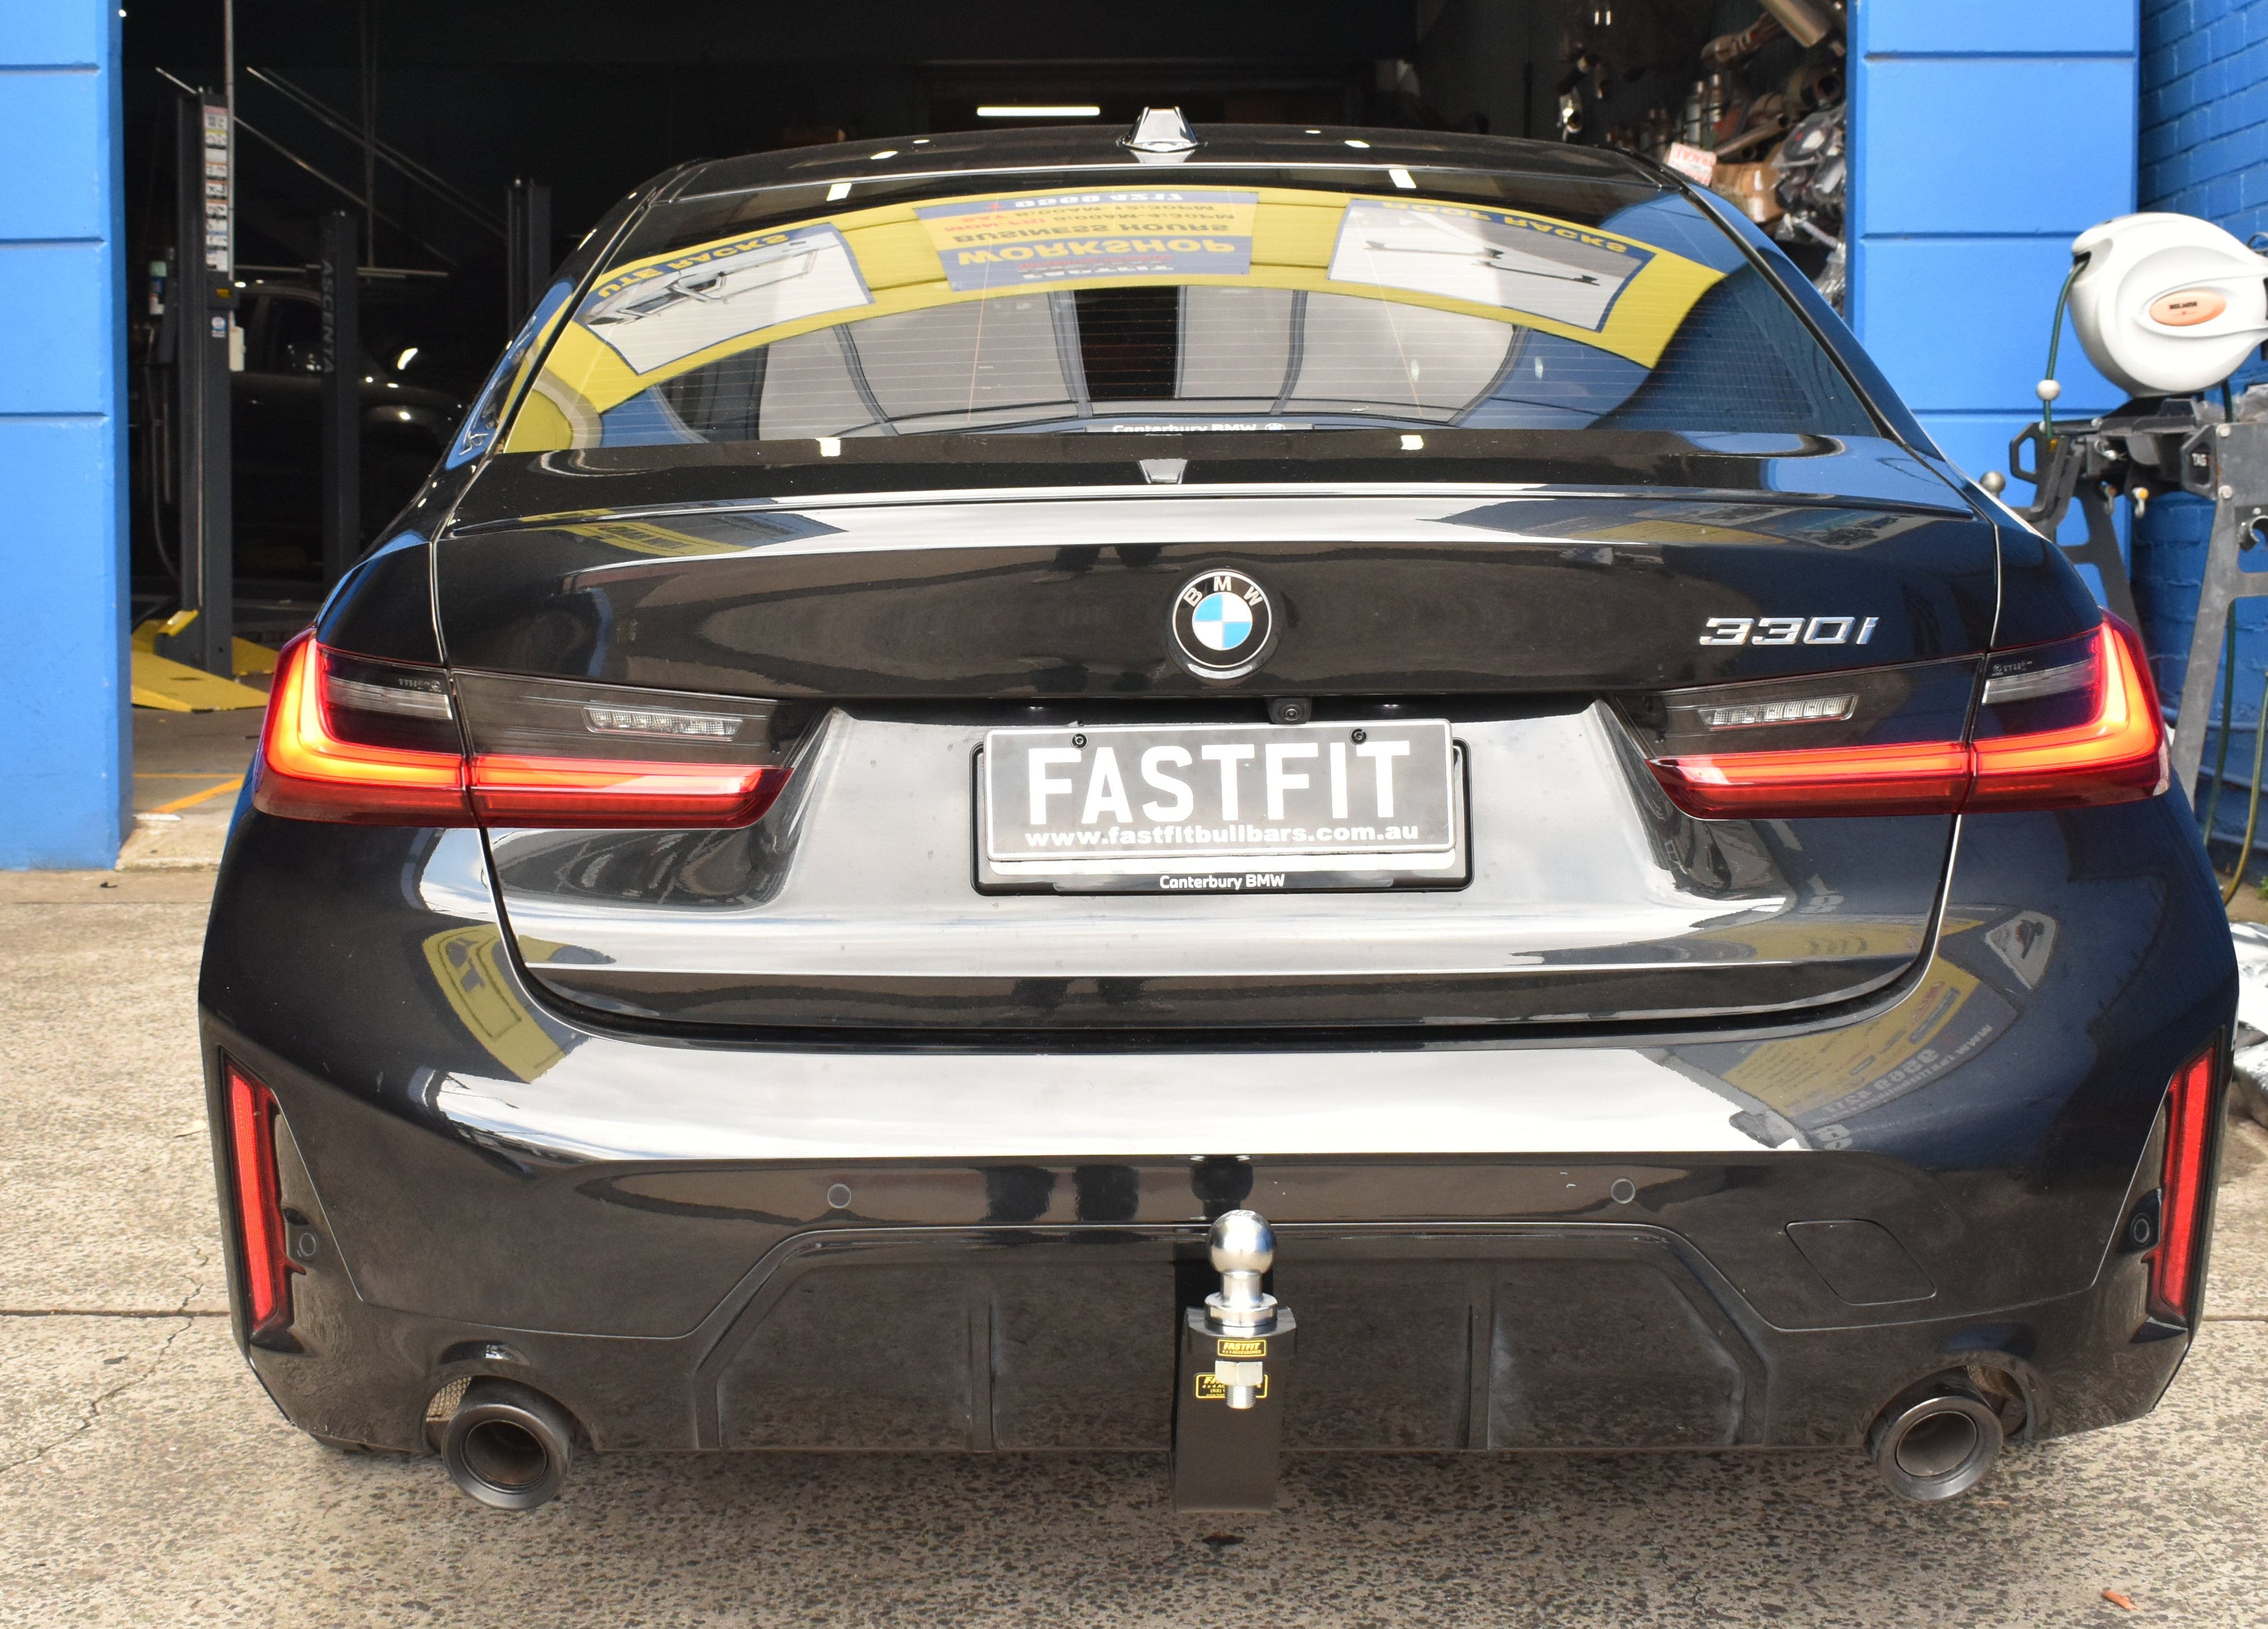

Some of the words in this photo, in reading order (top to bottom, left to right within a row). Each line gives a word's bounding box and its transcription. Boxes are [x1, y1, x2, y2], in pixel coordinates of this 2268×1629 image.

[322, 259, 335, 372] ASCENTA
[1183, 576, 1263, 607] BMW
[1699, 617, 1879, 645] 330i
[1029, 741, 1410, 825] FASTFIT
[1026, 823, 1418, 846] www.fastfitbullbars.com.au
[1160, 875, 1243, 890] Canterbury
[1245, 874, 1285, 887] BMW
[1223, 1342, 1260, 1351] FASTFIT
